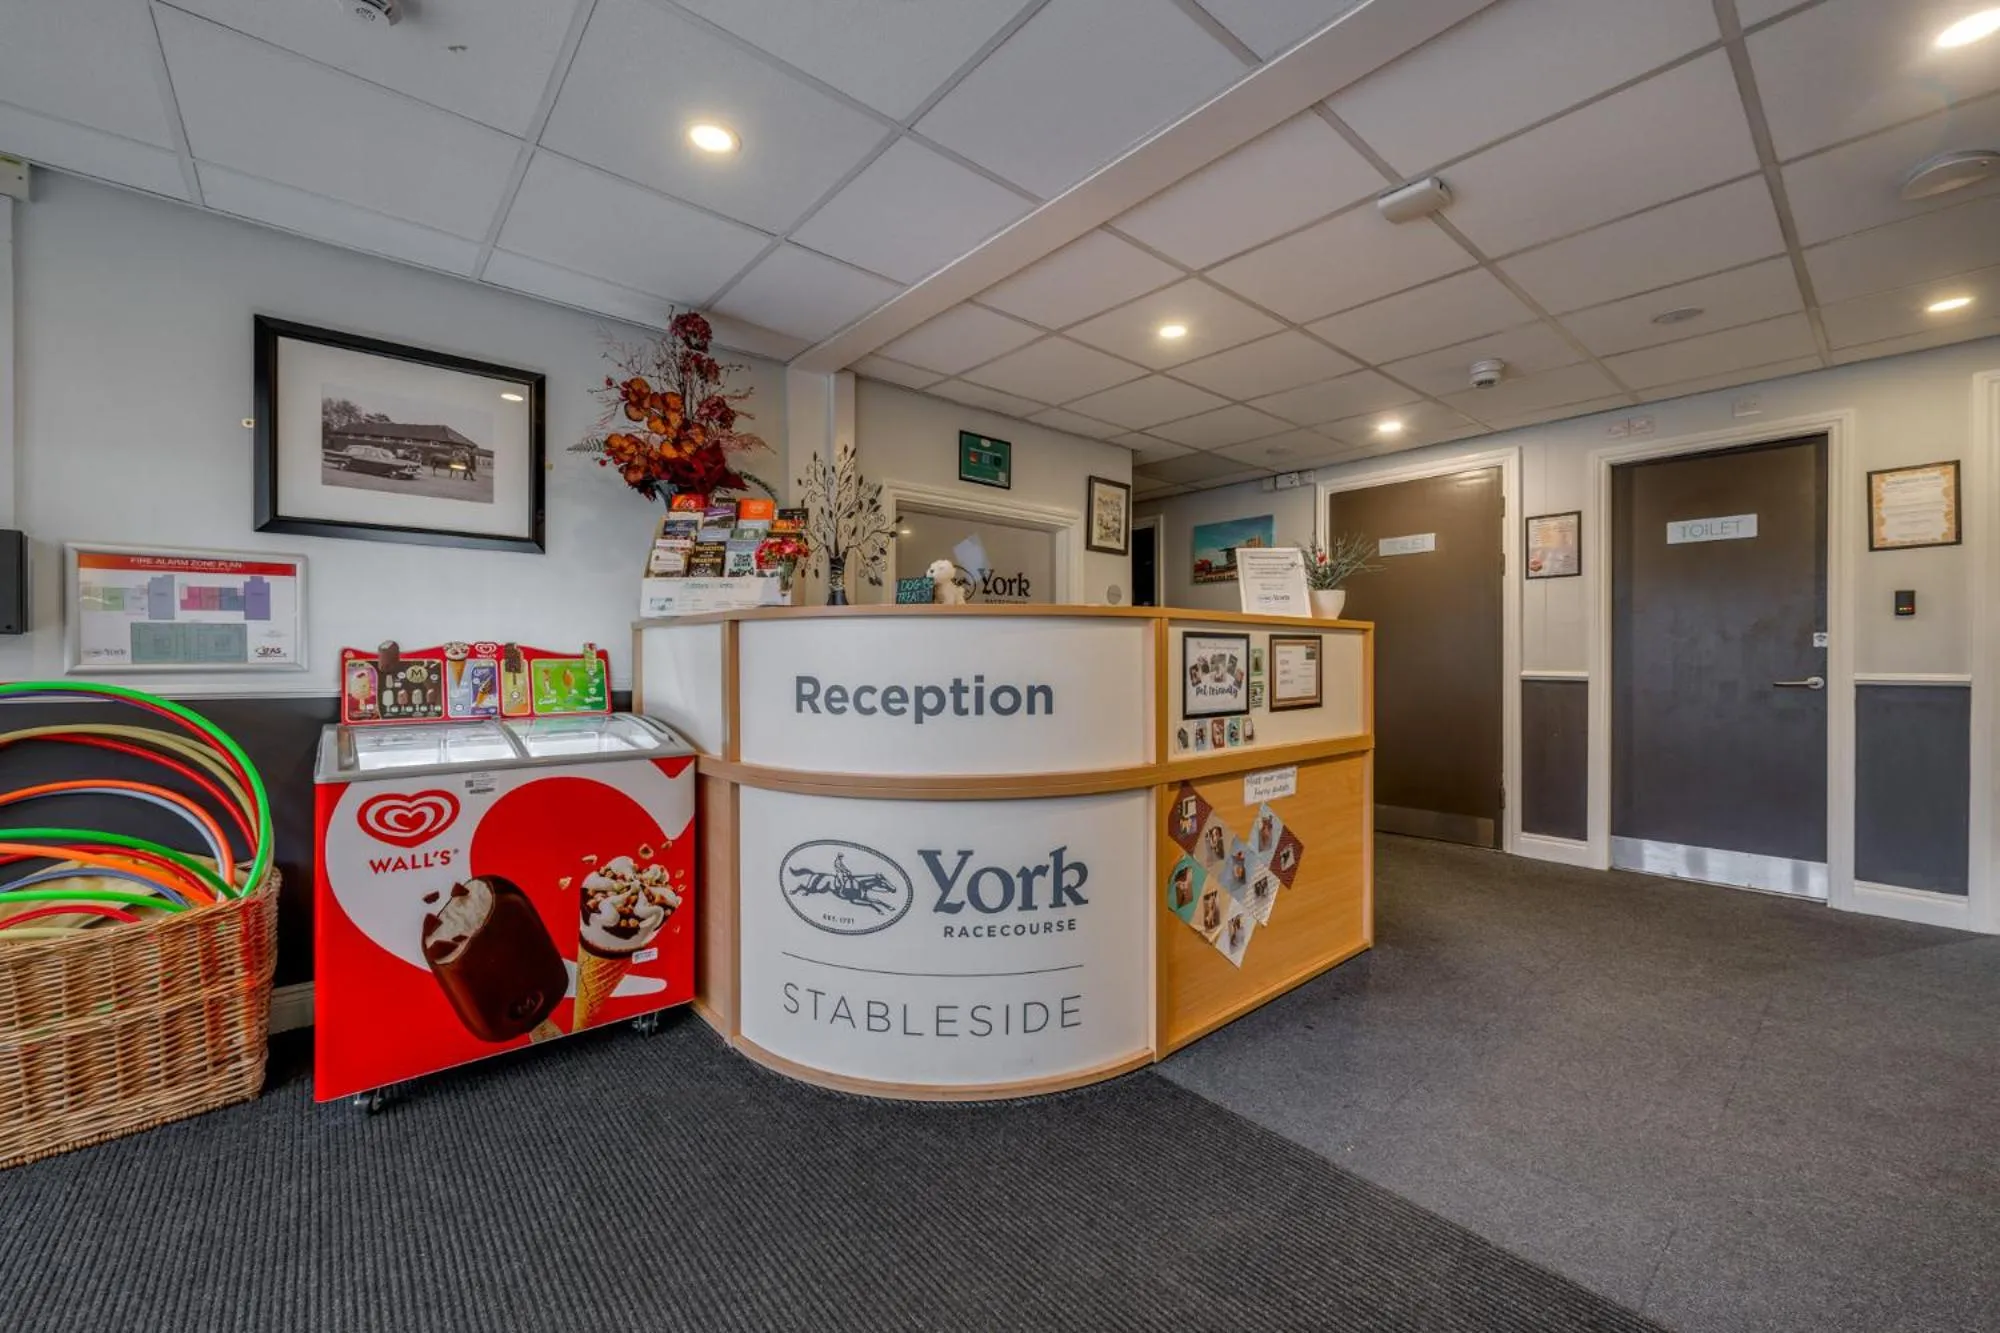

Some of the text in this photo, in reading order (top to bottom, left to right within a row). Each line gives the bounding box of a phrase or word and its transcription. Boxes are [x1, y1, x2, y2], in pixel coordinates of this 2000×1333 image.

[130, 557, 153, 565] FIRE
[155, 558, 189, 566] ALARM
[190, 559, 214, 568] ZONE
[219, 561, 243, 569] PLAN
[979, 567, 1031, 597] York
[795, 674, 1054, 725] Reception
[368, 849, 451, 875] WALL'S
[917, 845, 1090, 915] York
[943, 918, 1077, 938] RACECOURSE
[783, 982, 1082, 1038] STABLESIDE
